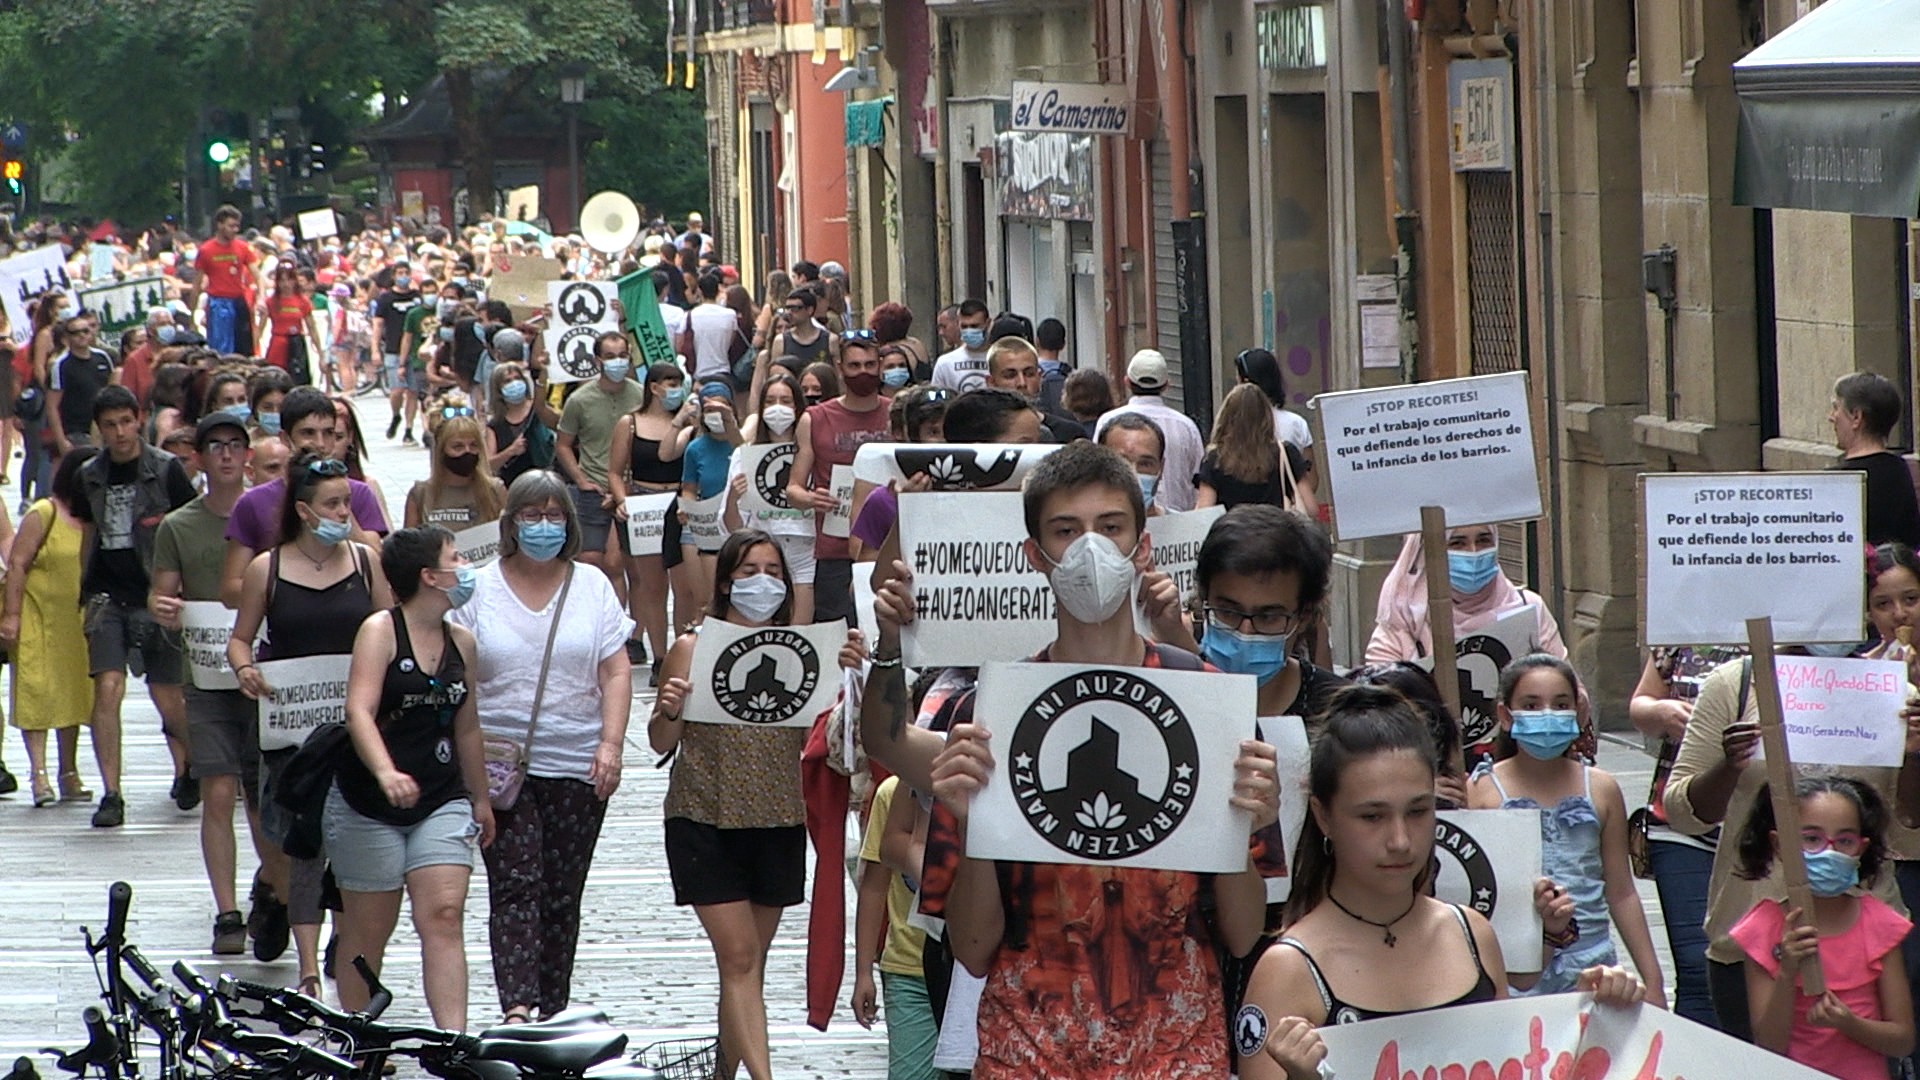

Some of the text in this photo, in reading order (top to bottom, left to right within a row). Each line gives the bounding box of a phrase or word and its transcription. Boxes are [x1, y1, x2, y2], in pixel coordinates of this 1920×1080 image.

[1015, 89, 1128, 130] el Camerino
[1366, 390, 1479, 416] ¡STOP RECORTES!
[1343, 408, 1511, 437] Por el trabajo comunitario
[1337, 424, 1521, 457] que defiende los derechos de
[1352, 444, 1511, 471] la infancia de los barrios.
[1694, 488, 1813, 504] ¡STOP RECORTES!
[1667, 511, 1844, 527] Por el trabajo comunitario
[1658, 531, 1854, 549] que defiende los derechos de
[1672, 551, 1841, 565] la infancia de los barrios.
[729, 632, 812, 657] NI AUZOAN
[714, 681, 813, 722] GERATZEN NAIZ
[1034, 675, 1180, 729] NI AUZOAN
[1014, 771, 1192, 855] GERATZEN NAIZ
